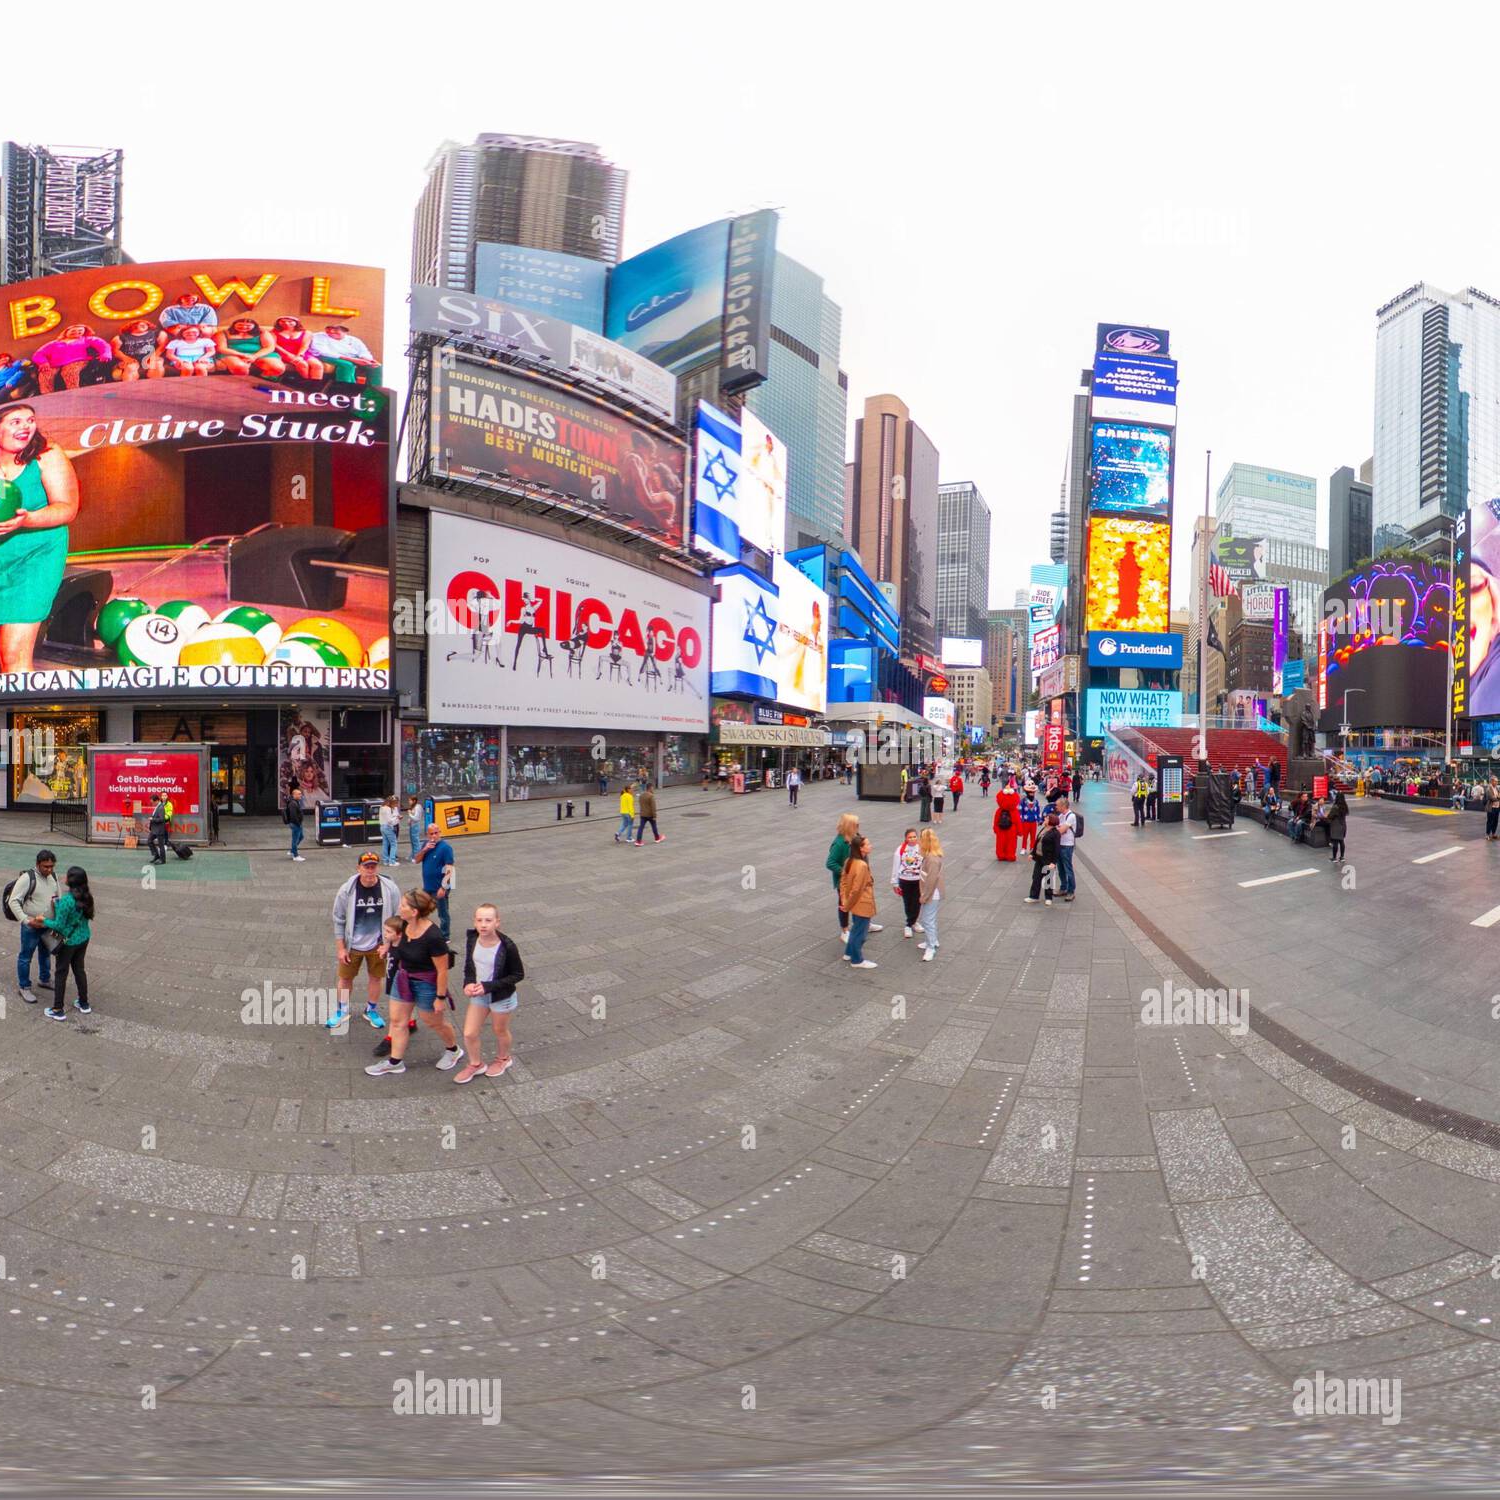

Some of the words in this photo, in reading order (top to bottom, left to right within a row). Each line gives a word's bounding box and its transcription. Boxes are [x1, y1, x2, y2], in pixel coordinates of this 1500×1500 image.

[499, 251, 581, 273] Sleep
[499, 263, 581, 284] more.
[498, 287, 561, 306] less.
[499, 276, 584, 300] Stress
[9, 272, 361, 341] BOWL
[627, 288, 690, 321] Calm
[436, 293, 554, 352] SIX
[724, 272, 754, 368] SQUARE
[1105, 373, 1166, 385] AMERICAN
[1116, 367, 1156, 377] HAPPY
[268, 387, 376, 413] meet:
[1114, 386, 1157, 396] MONTH
[448, 370, 518, 396] BROADWAY'S
[519, 390, 568, 412] GREATEST
[569, 406, 591, 424] LOVE
[592, 415, 618, 434] STORY
[79, 414, 225, 449] Claire
[238, 410, 377, 448] Stuck
[448, 385, 619, 466] HADESTOWN
[448, 413, 495, 433] WINNER!
[508, 428, 533, 445] TONY
[484, 432, 525, 454] BEST
[531, 446, 594, 480] MUSICAL
[1456, 511, 1467, 539] BE
[473, 555, 490, 564] POP
[526, 567, 537, 575] SIX
[565, 577, 591, 588] SQUISH
[1246, 585, 1269, 597] LITTLE
[1031, 595, 1054, 604] STREET
[1035, 589, 1051, 598] SIDE
[1455, 577, 1467, 621] APP
[152, 621, 171, 637] 14
[446, 570, 703, 670] CHICAGO
[1120, 642, 1173, 655] Prudential
[1453, 624, 1466, 676] TSX
[98, 666, 190, 689] EAGLE
[199, 665, 388, 689] OUTFITTERS
[447, 702, 493, 710] AMBASSADOR
[1100, 690, 1127, 705] NOW
[1129, 692, 1170, 706] WHAT?
[1453, 678, 1465, 720] HE
[758, 707, 773, 718] BLUE
[773, 710, 783, 719] FIN
[721, 729, 787, 742] SWAROVSKI
[1049, 726, 1062, 751] tkts
[108, 785, 137, 793] tickets
[138, 785, 146, 793] in
[147, 785, 186, 793] seconds.
[116, 775, 133, 784] Get
[134, 775, 177, 785] Broadway
